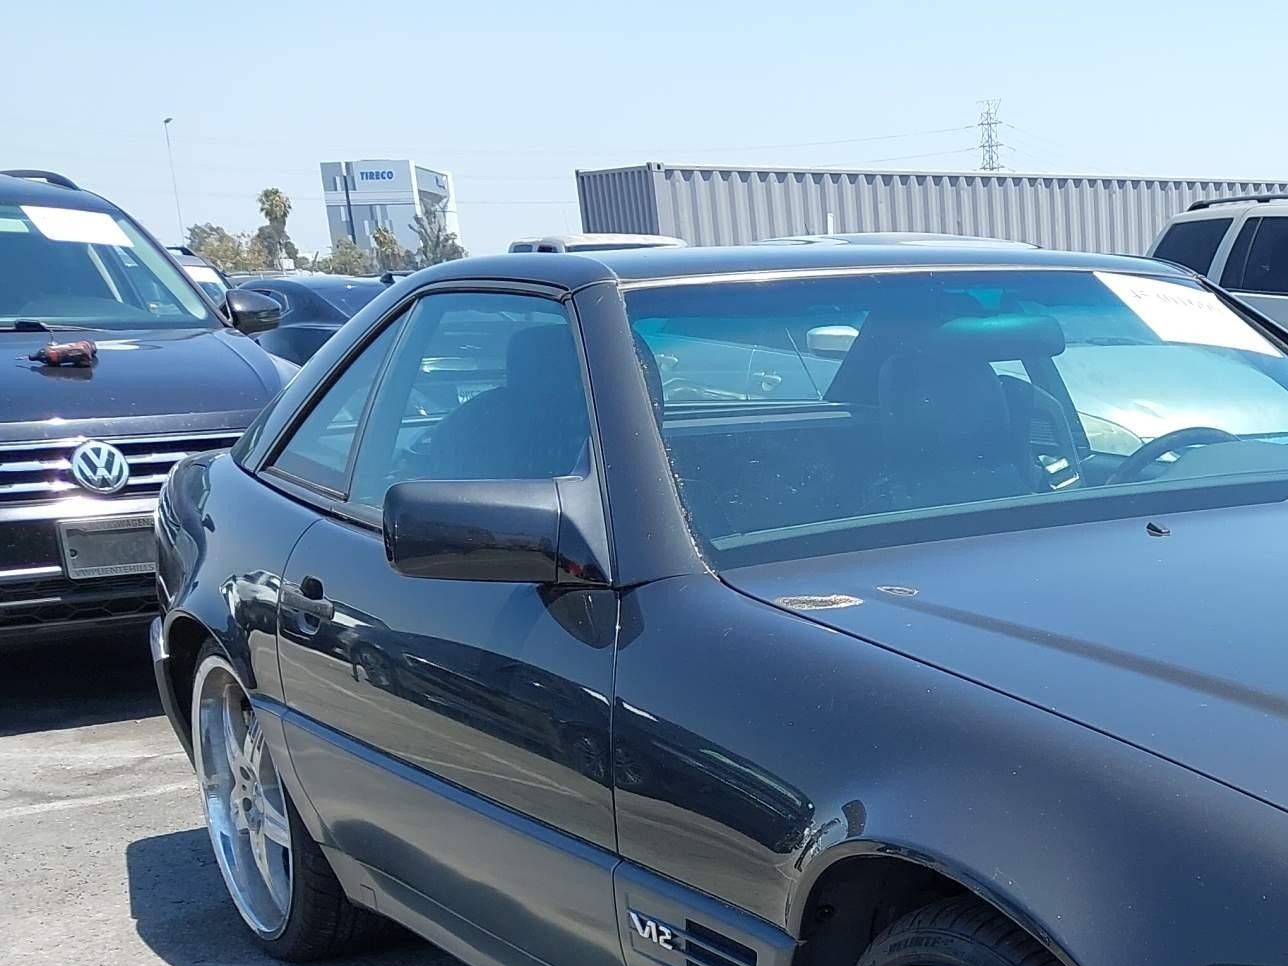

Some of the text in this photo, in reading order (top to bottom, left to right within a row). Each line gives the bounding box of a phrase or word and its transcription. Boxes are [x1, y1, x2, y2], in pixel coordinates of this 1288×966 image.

[359, 170, 394, 181] TIRECO
[75, 442, 125, 490] VW
[630, 911, 673, 950] V12
